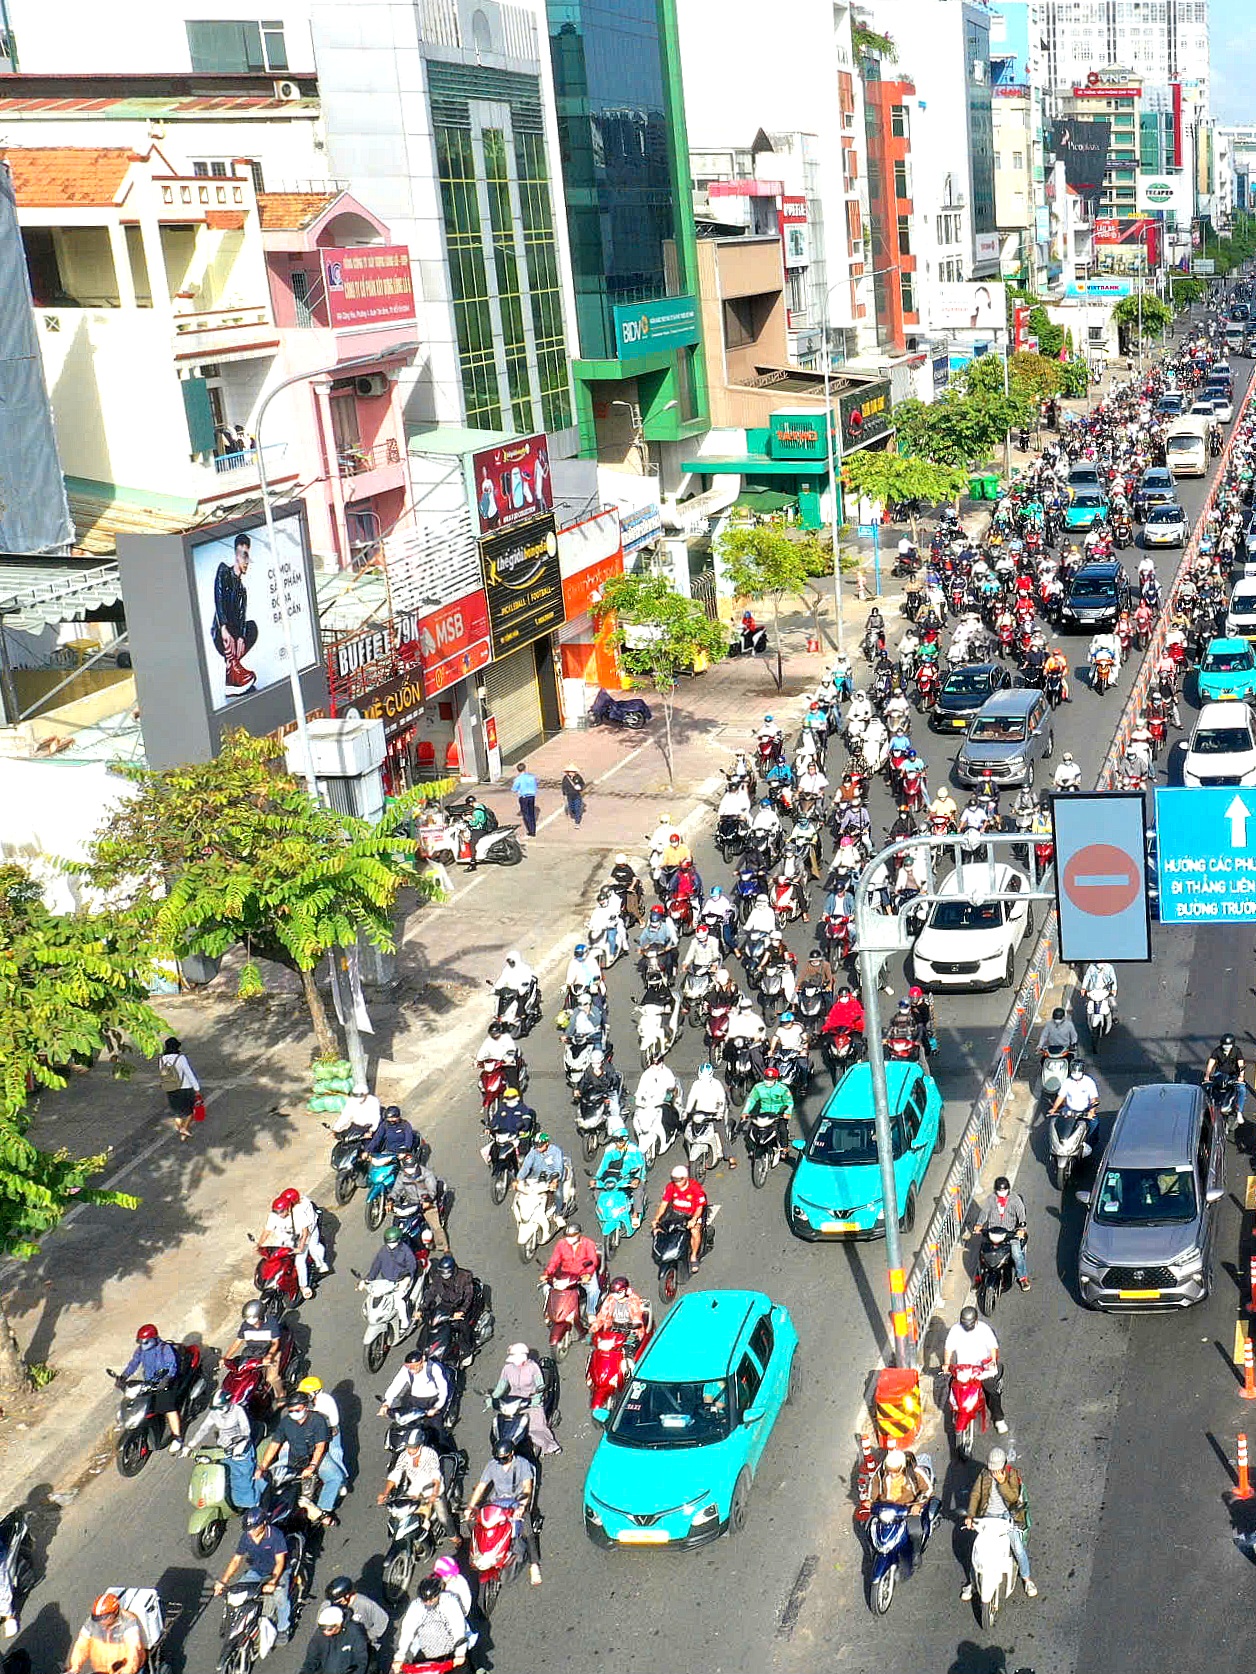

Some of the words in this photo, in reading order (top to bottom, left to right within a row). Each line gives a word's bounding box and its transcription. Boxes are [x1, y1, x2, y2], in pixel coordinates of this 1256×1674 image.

[622, 320, 641, 343] BIDV
[435, 613, 464, 648] MSB
[338, 629, 391, 677] BUFFET
[394, 613, 419, 650] 79K
[385, 677, 420, 717] CUỐN
[1209, 854, 1232, 872] CÁC
[1171, 881, 1183, 895] ĐI
[1230, 877, 1256, 893] LIÊN
[1176, 898, 1219, 917] ĐƯỜNG
